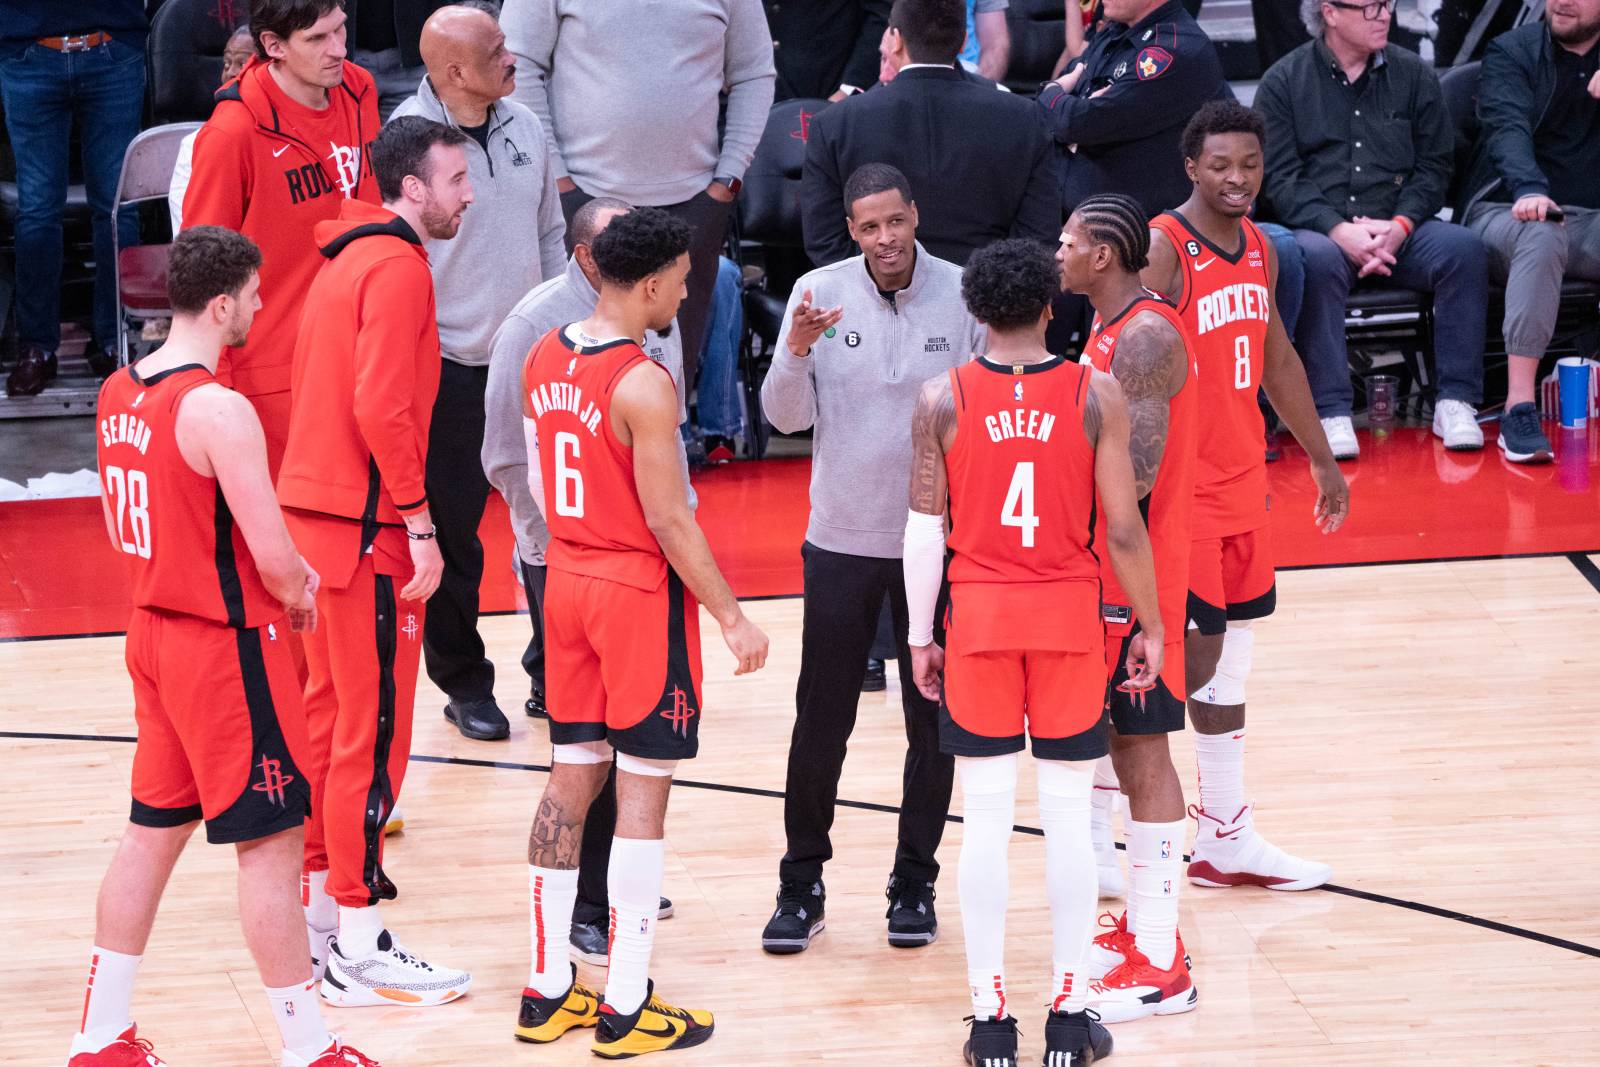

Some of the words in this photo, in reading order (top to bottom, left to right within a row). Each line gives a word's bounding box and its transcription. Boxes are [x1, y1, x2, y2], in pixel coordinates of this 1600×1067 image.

[1188, 241, 1199, 256] 6
[1197, 283, 1269, 336] ROCKETS
[848, 333, 858, 346] 6
[924, 343, 950, 352] ROCKETS
[1234, 335, 1251, 390] 8
[101, 413, 152, 455] SENGUN
[531, 382, 581, 419] MARTIN
[580, 400, 602, 437] JR.
[985, 408, 1056, 443] GREEN
[555, 431, 584, 518] 6
[106, 464, 152, 560] 28
[1000, 462, 1040, 547] 4
